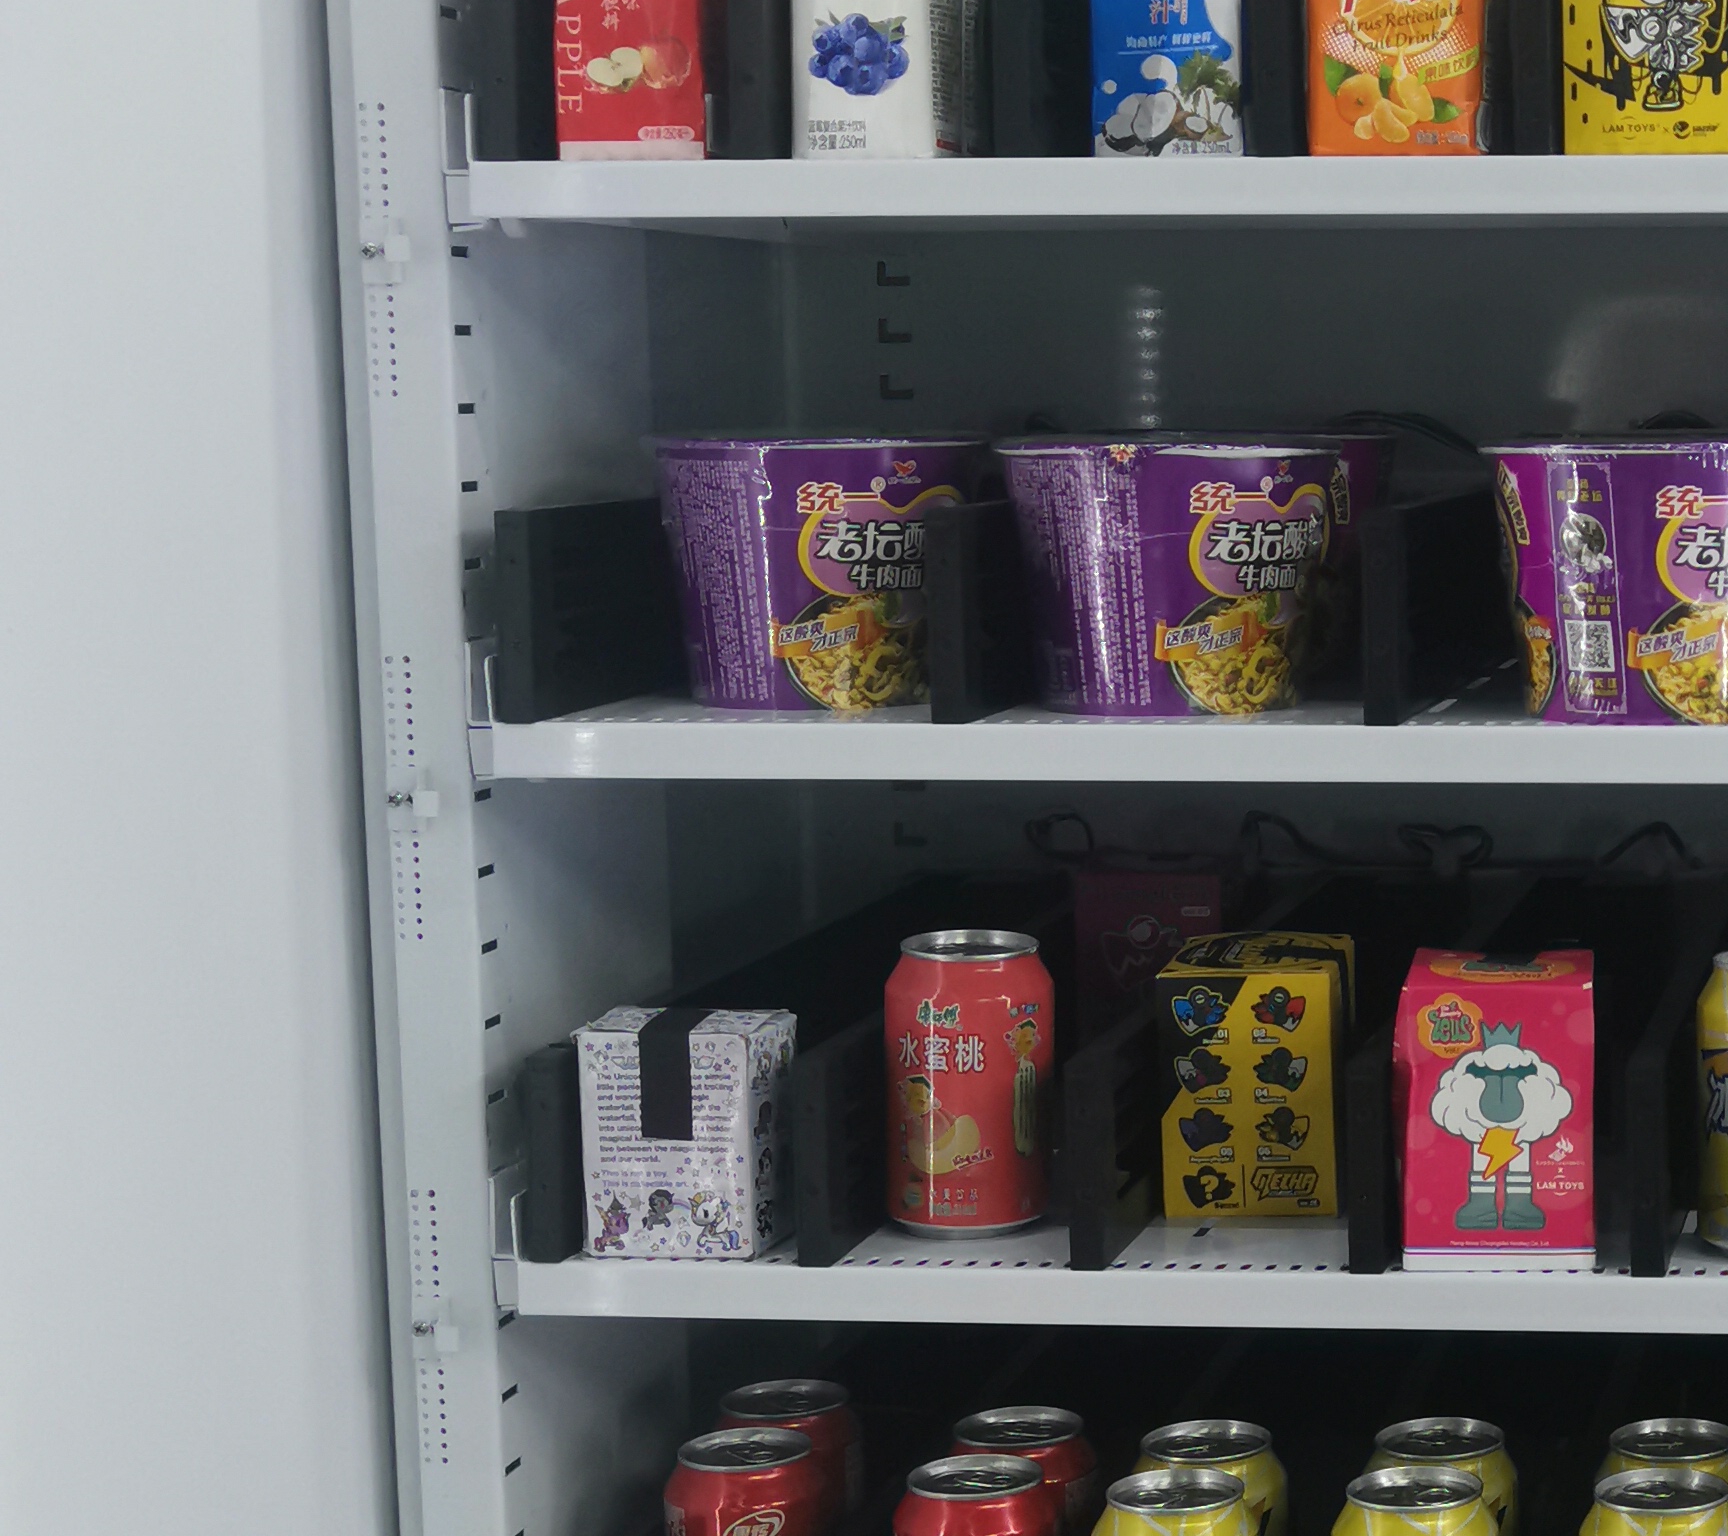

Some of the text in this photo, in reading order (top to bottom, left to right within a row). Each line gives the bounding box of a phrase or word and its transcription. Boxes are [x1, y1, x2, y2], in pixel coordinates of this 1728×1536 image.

[797, 482, 881, 515] 统一
[1188, 481, 1268, 515] 统一
[850, 563, 923, 591] 牛肉面
[1236, 564, 1298, 592] 牛肉面
[898, 1034, 985, 1074] 水蜜桃
[1536, 1182, 1585, 1190] LAM TOYS
